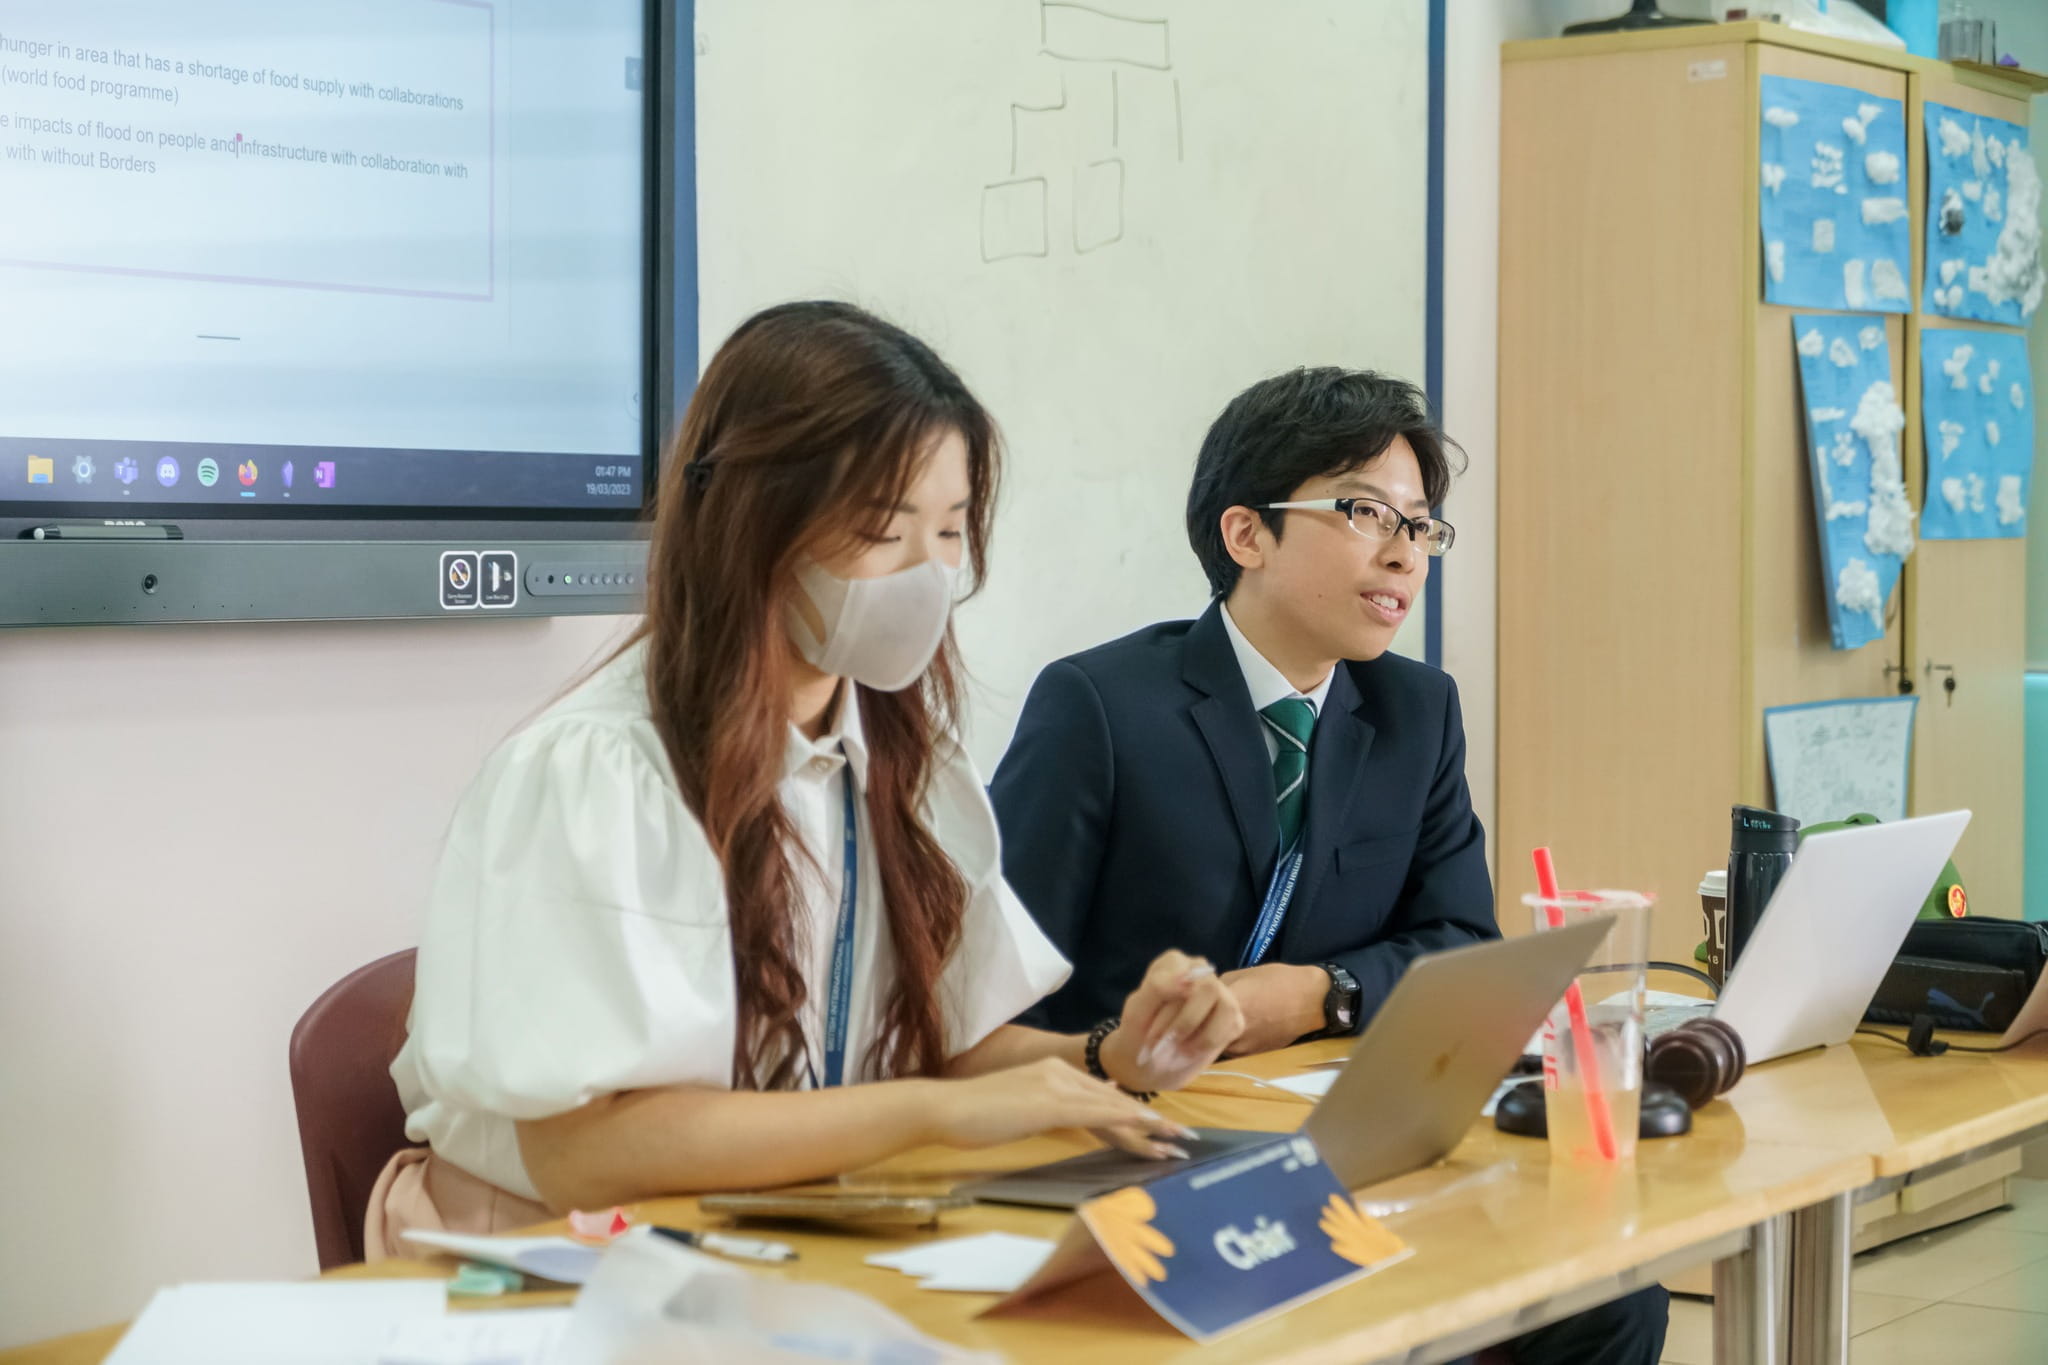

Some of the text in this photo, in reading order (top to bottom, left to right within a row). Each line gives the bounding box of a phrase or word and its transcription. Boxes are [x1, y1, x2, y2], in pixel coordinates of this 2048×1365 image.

[2, 64, 179, 106] (world food programme)
[57, 41, 70, 59] in
[75, 47, 109, 64] area
[113, 49, 140, 69] that
[145, 53, 171, 72] has
[175, 60, 184, 74] a
[188, 59, 249, 85] shortage
[253, 69, 266, 85] of
[270, 70, 299, 89] food
[303, 77, 345, 98] supply
[349, 82, 375, 99] with
[378, 86, 464, 111] collaborations
[6, 142, 157, 174] with without Borders
[14, 112, 73, 135] impacts
[77, 120, 92, 136] of
[96, 121, 131, 141] flood
[136, 129, 154, 143] on
[158, 131, 206, 152] people
[210, 136, 236, 153] and
[240, 138, 328, 164] infrastructure
[331, 150, 357, 166] with
[361, 152, 440, 176] collaboration
[444, 161, 469, 179] with
[586, 483, 631, 495] 19/03/2023
[618, 466, 631, 477] PM
[1268, 880, 1295, 937] INTERNATIONAL
[1213, 1214, 1297, 1271] Chair
